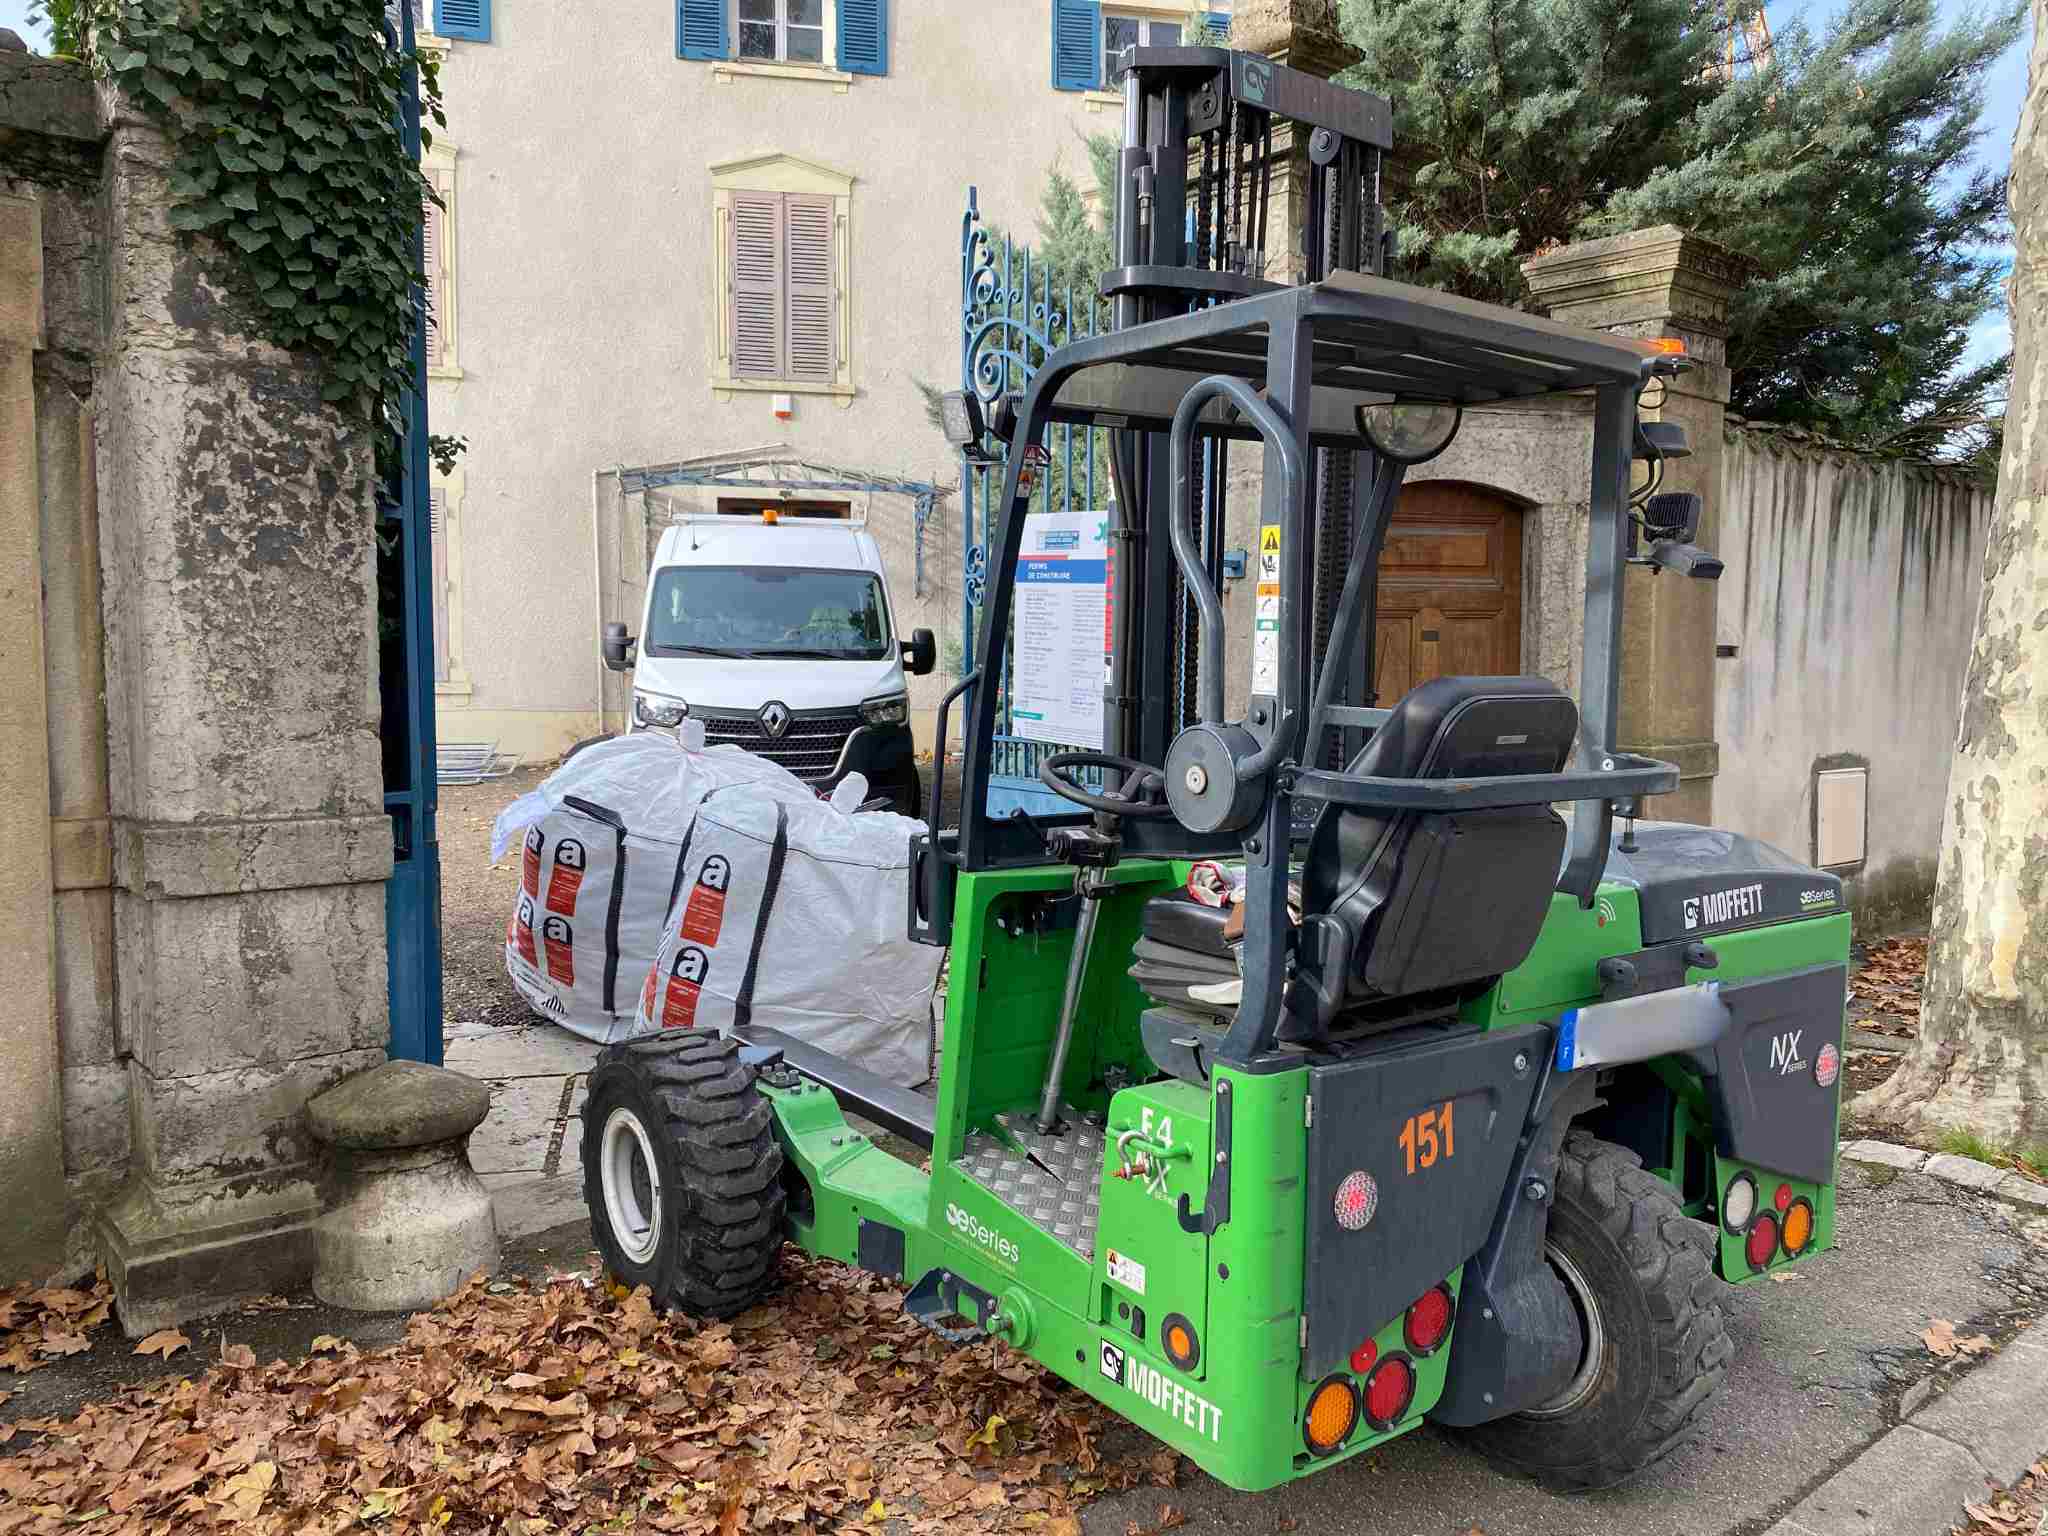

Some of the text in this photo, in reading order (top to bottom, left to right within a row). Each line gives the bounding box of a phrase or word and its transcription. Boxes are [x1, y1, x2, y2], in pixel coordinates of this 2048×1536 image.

[702, 857, 727, 889] a
[1703, 884, 1762, 925] MOFFETT
[676, 949, 703, 982] a
[1770, 1030, 1802, 1075] NX
[1787, 1060, 1807, 1073] SERIES
[1400, 1102, 1454, 1176] 151
[1127, 1356, 1222, 1443] MOFFETT
